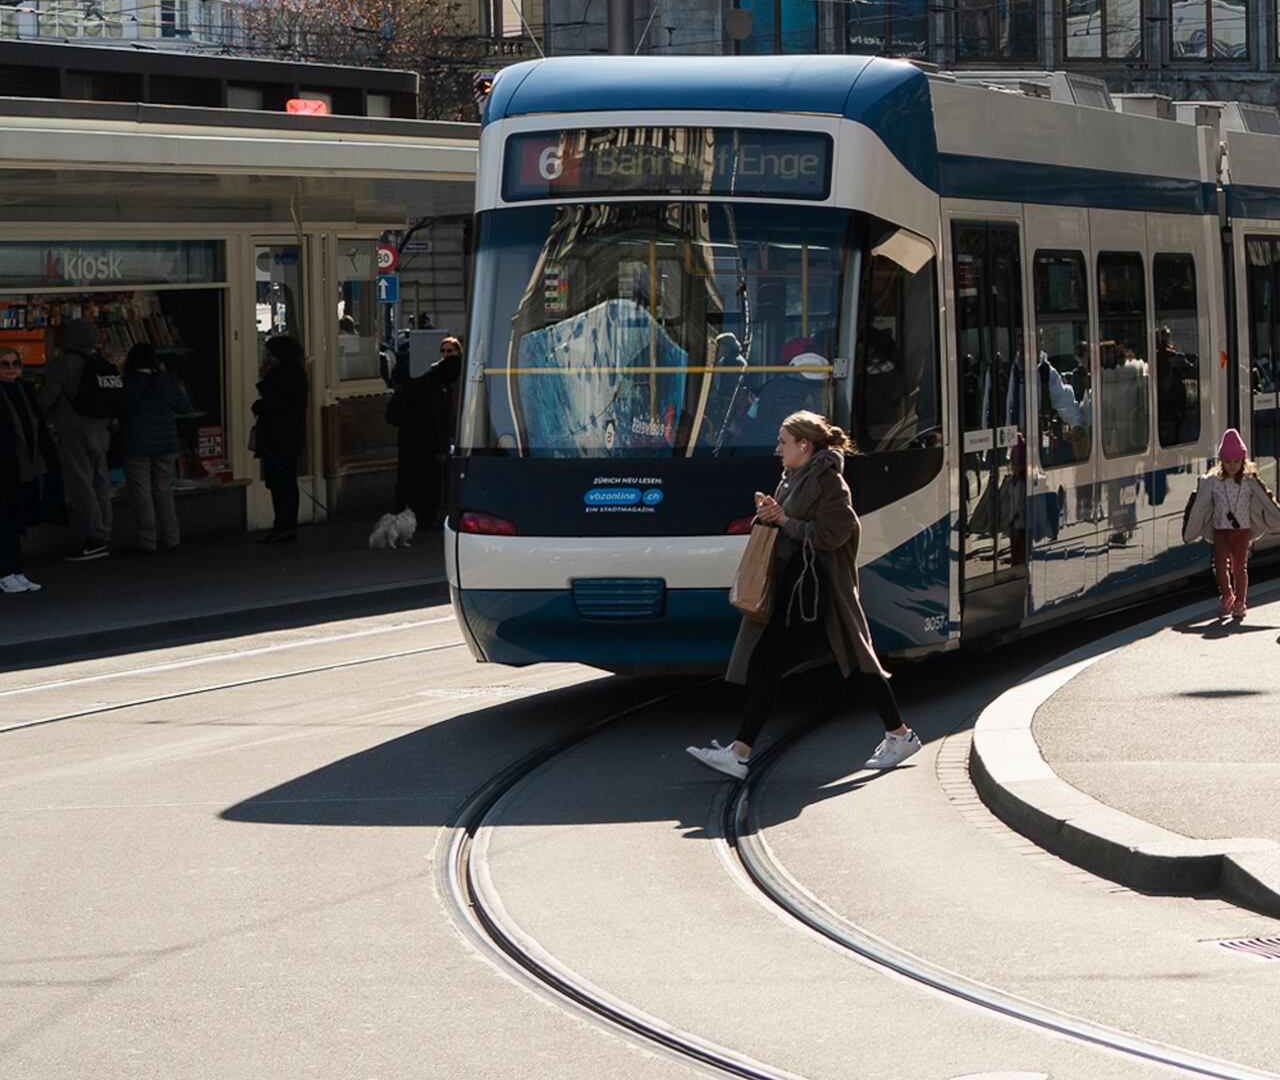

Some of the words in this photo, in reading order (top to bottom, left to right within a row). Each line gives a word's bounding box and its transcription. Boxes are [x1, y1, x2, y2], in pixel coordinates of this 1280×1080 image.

[538, 145, 563, 180] 6
[738, 144, 819, 180] Enge
[46, 247, 62, 281] k
[63, 247, 123, 281] kiosk
[593, 476, 621, 485] ZÜRICH
[589, 491, 636, 501] vbzonline
[923, 615, 945, 632] 3057
